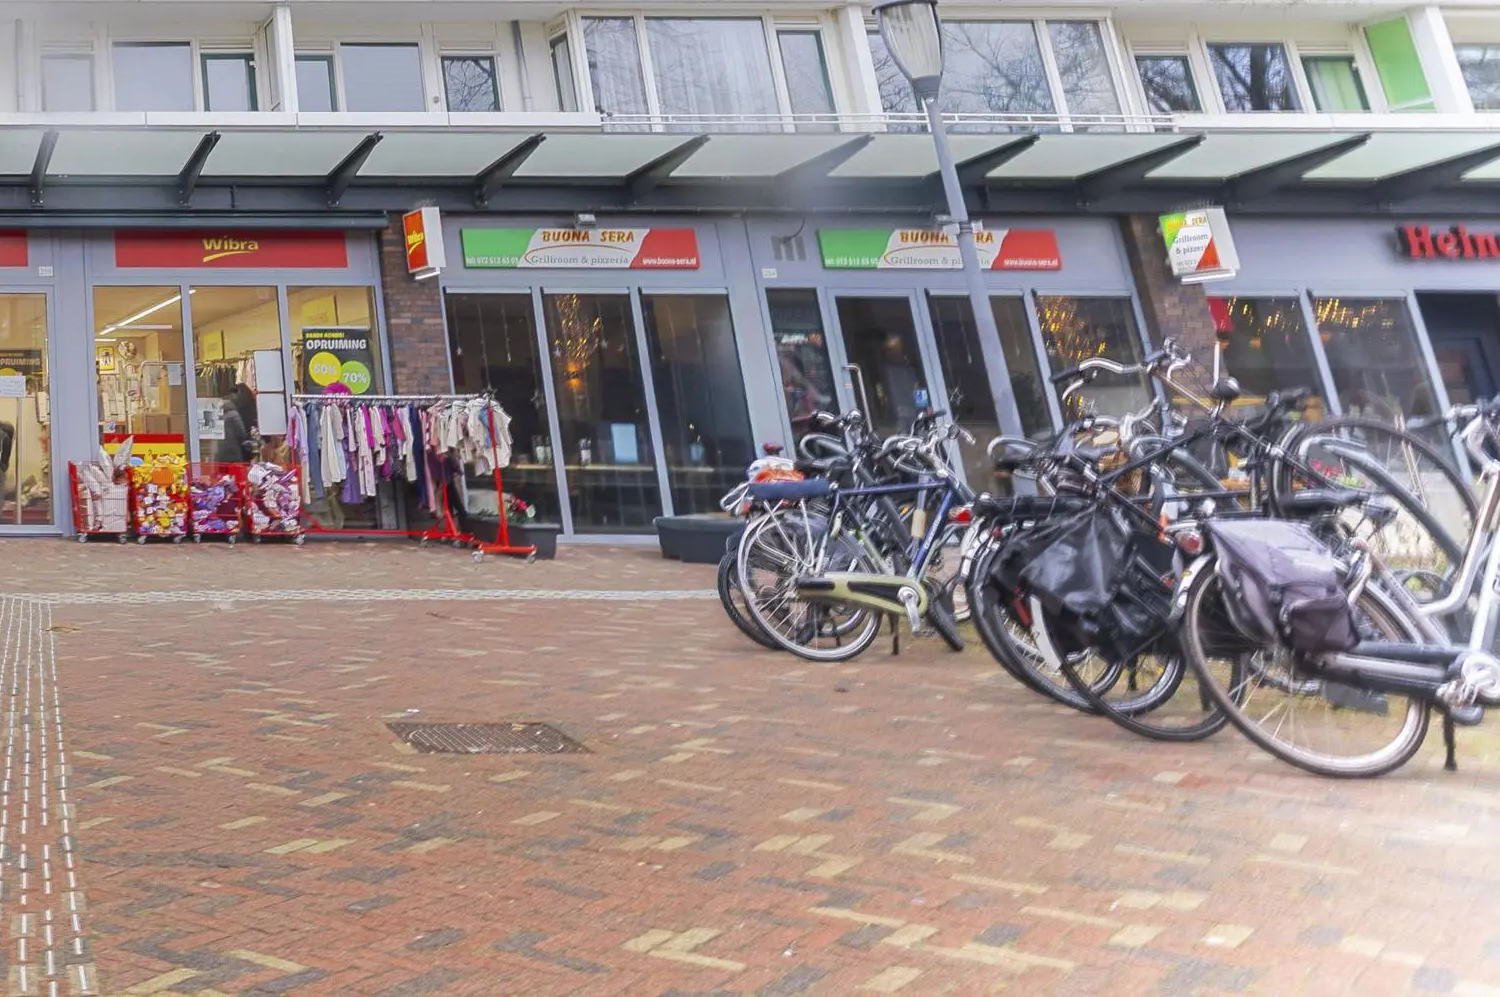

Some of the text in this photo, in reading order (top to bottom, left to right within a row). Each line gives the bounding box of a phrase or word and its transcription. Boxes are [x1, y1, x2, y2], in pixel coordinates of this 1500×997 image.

[202, 234, 259, 251] Wibra
[542, 230, 635, 243] BUONA SERA
[900, 230, 949, 243] BUONA
[530, 254, 628, 266] Grillroom & pizzeria
[890, 256, 937, 265] Grillroom
[941, 257, 949, 265] &
[305, 339, 367, 350] OPRUIMING
[342, 371, 367, 383] 70%
